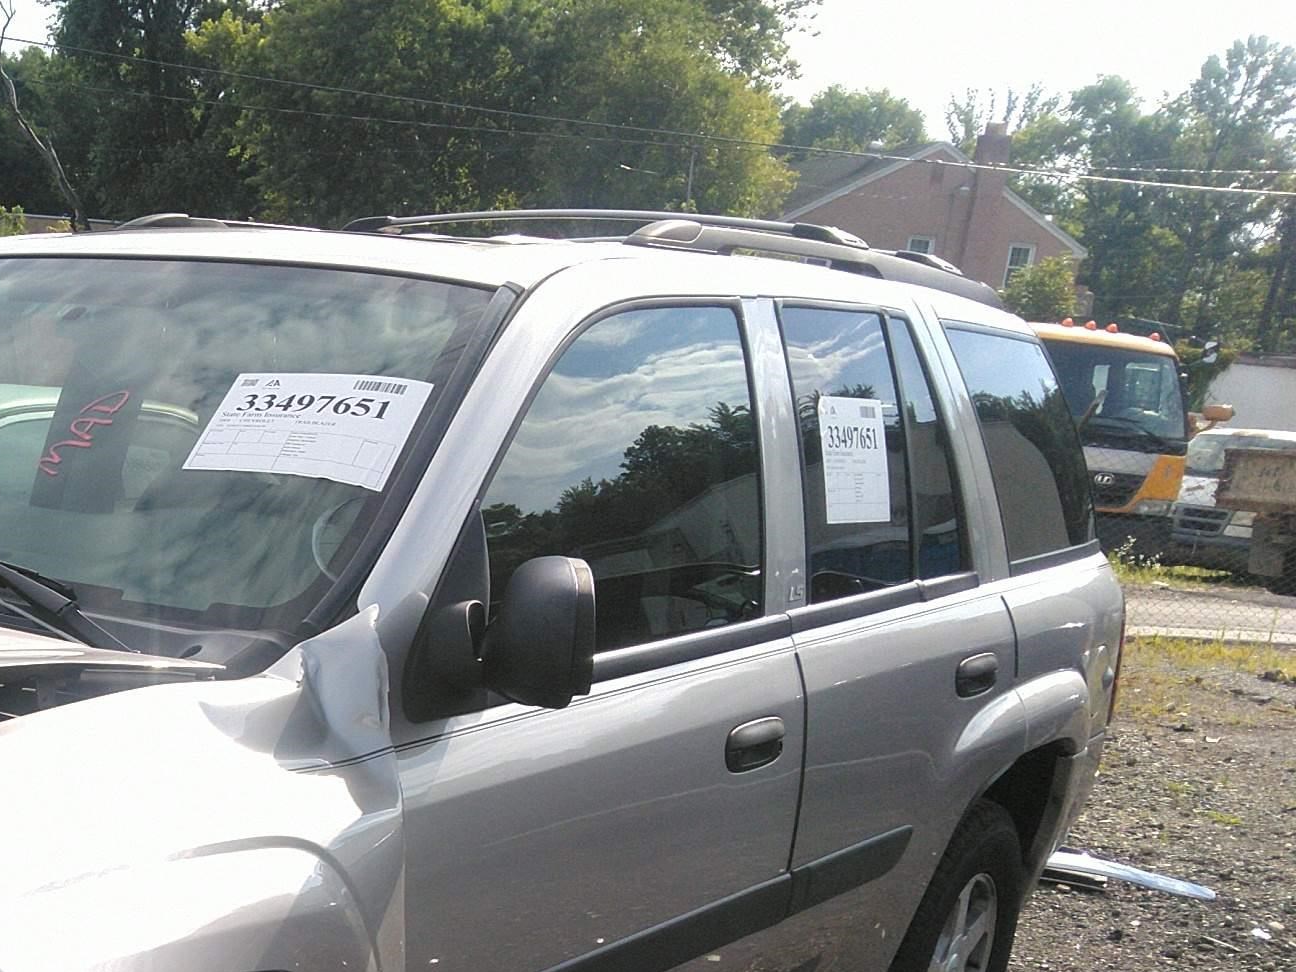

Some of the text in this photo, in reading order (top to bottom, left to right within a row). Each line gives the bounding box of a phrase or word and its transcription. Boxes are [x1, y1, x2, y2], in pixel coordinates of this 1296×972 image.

[236, 393, 392, 420] 33497651
[264, 411, 302, 419] Insurance
[827, 425, 878, 450] 33497651
